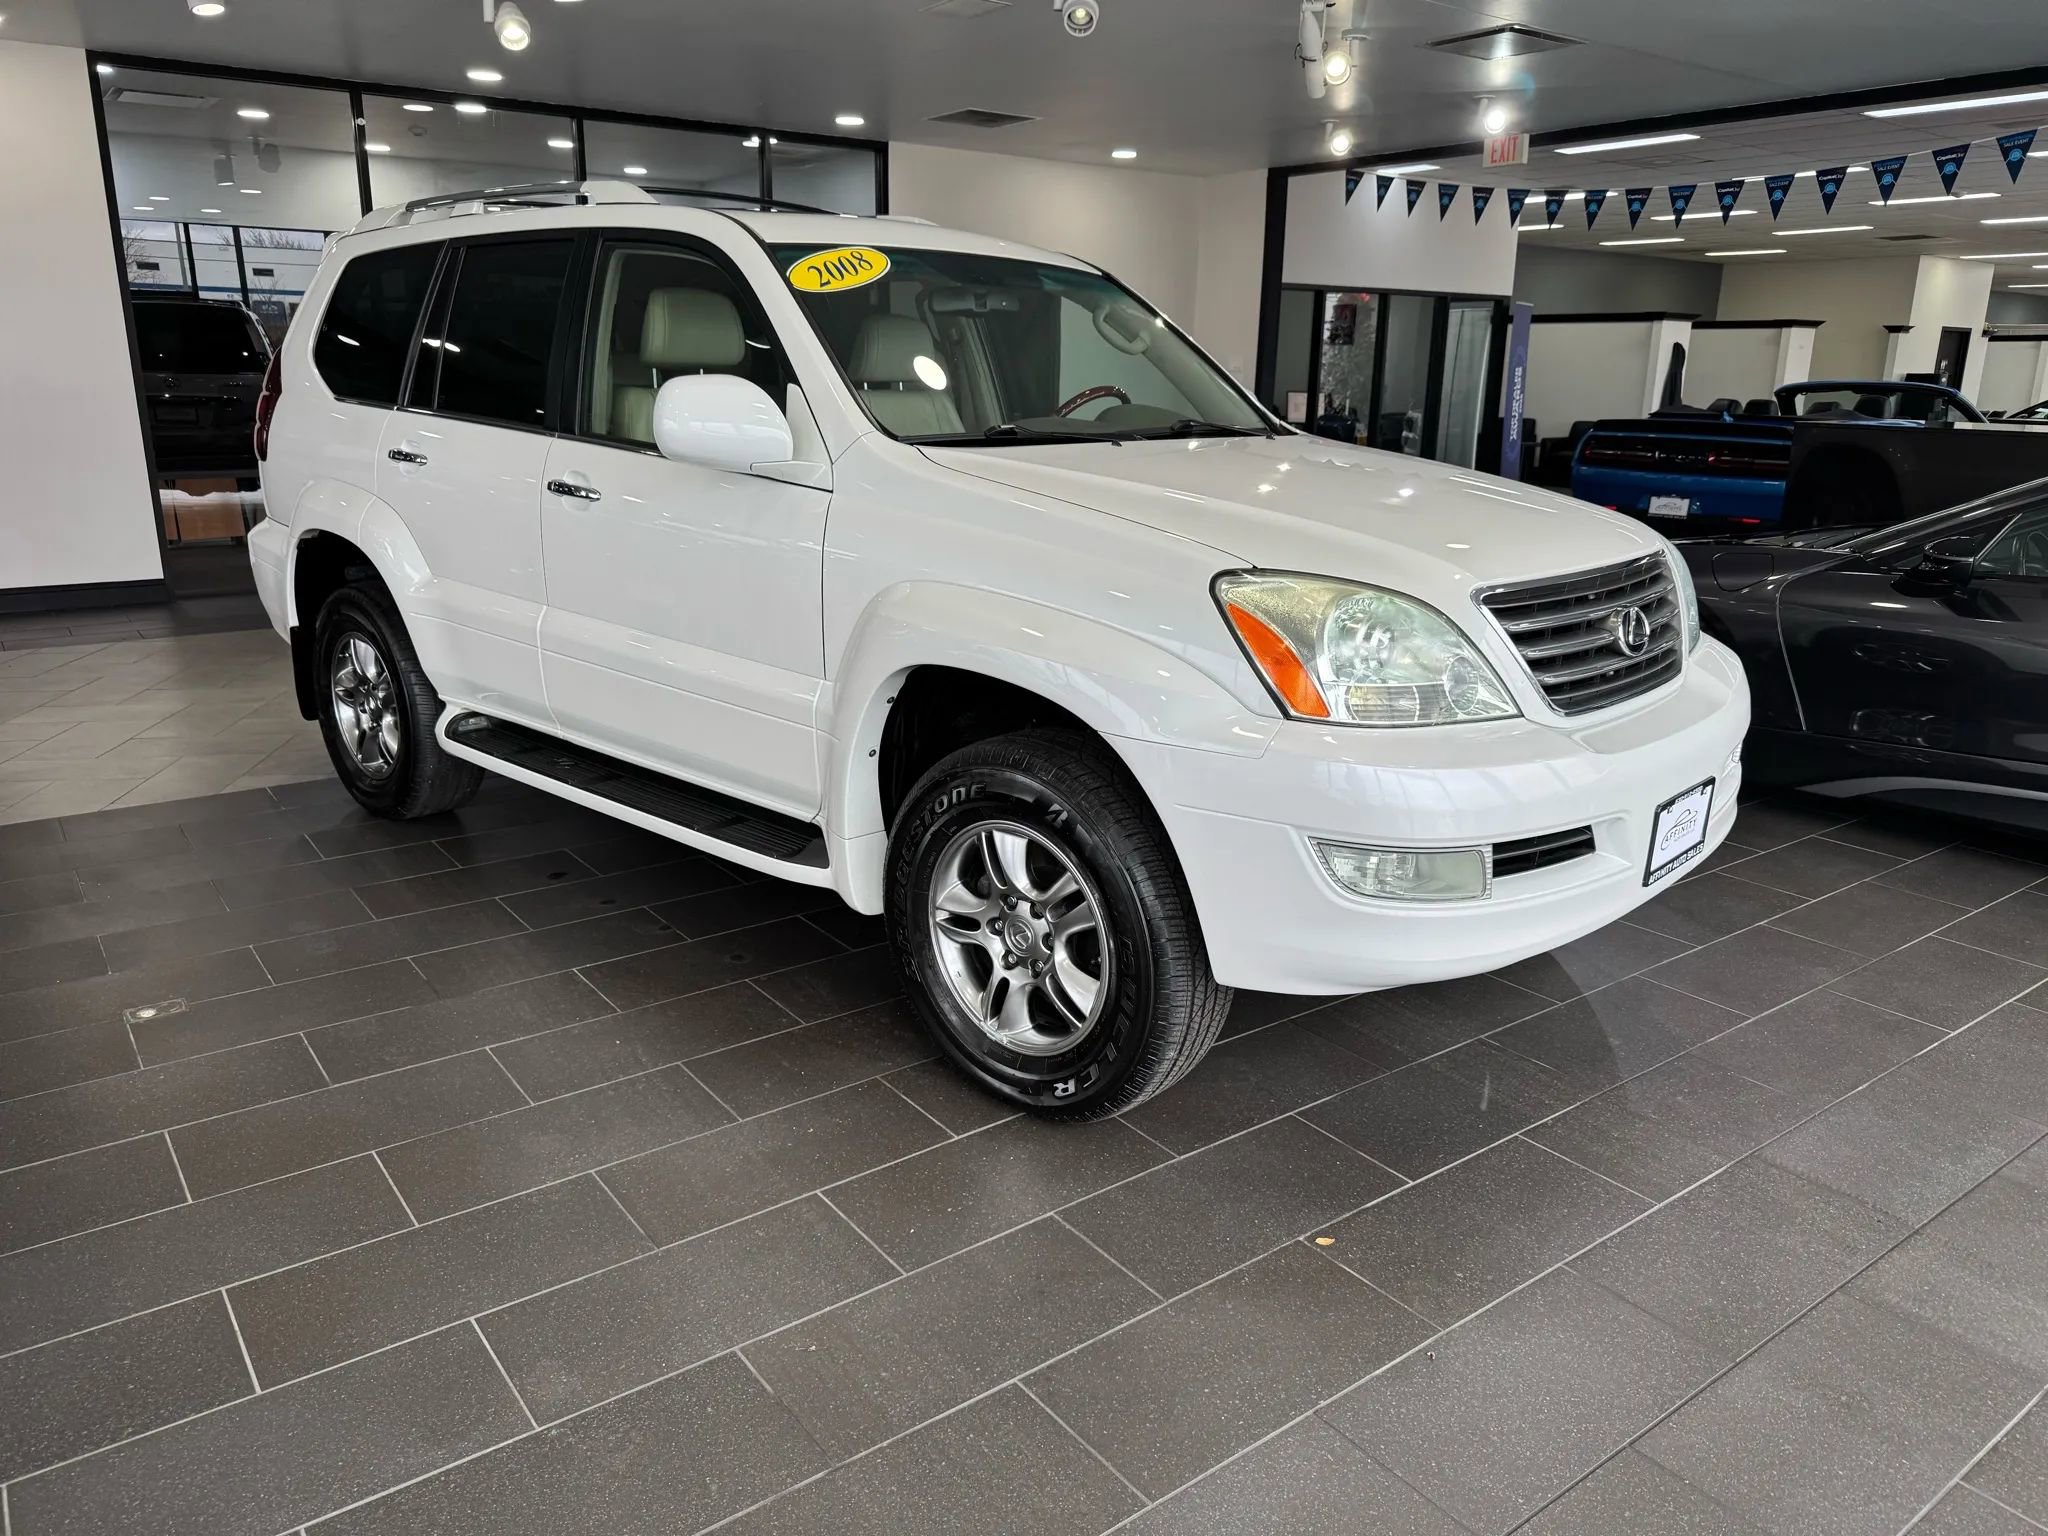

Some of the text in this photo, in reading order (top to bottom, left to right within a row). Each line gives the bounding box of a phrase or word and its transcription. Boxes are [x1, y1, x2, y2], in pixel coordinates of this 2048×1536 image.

[1490, 135, 1519, 163] EXIT
[807, 250, 873, 289] 2008
[1665, 820, 1696, 842] AFFINITY
[896, 782, 988, 983] BRIDGESTONE
[1648, 863, 1673, 884] AFFINITY
[1687, 843, 1704, 859] SALES
